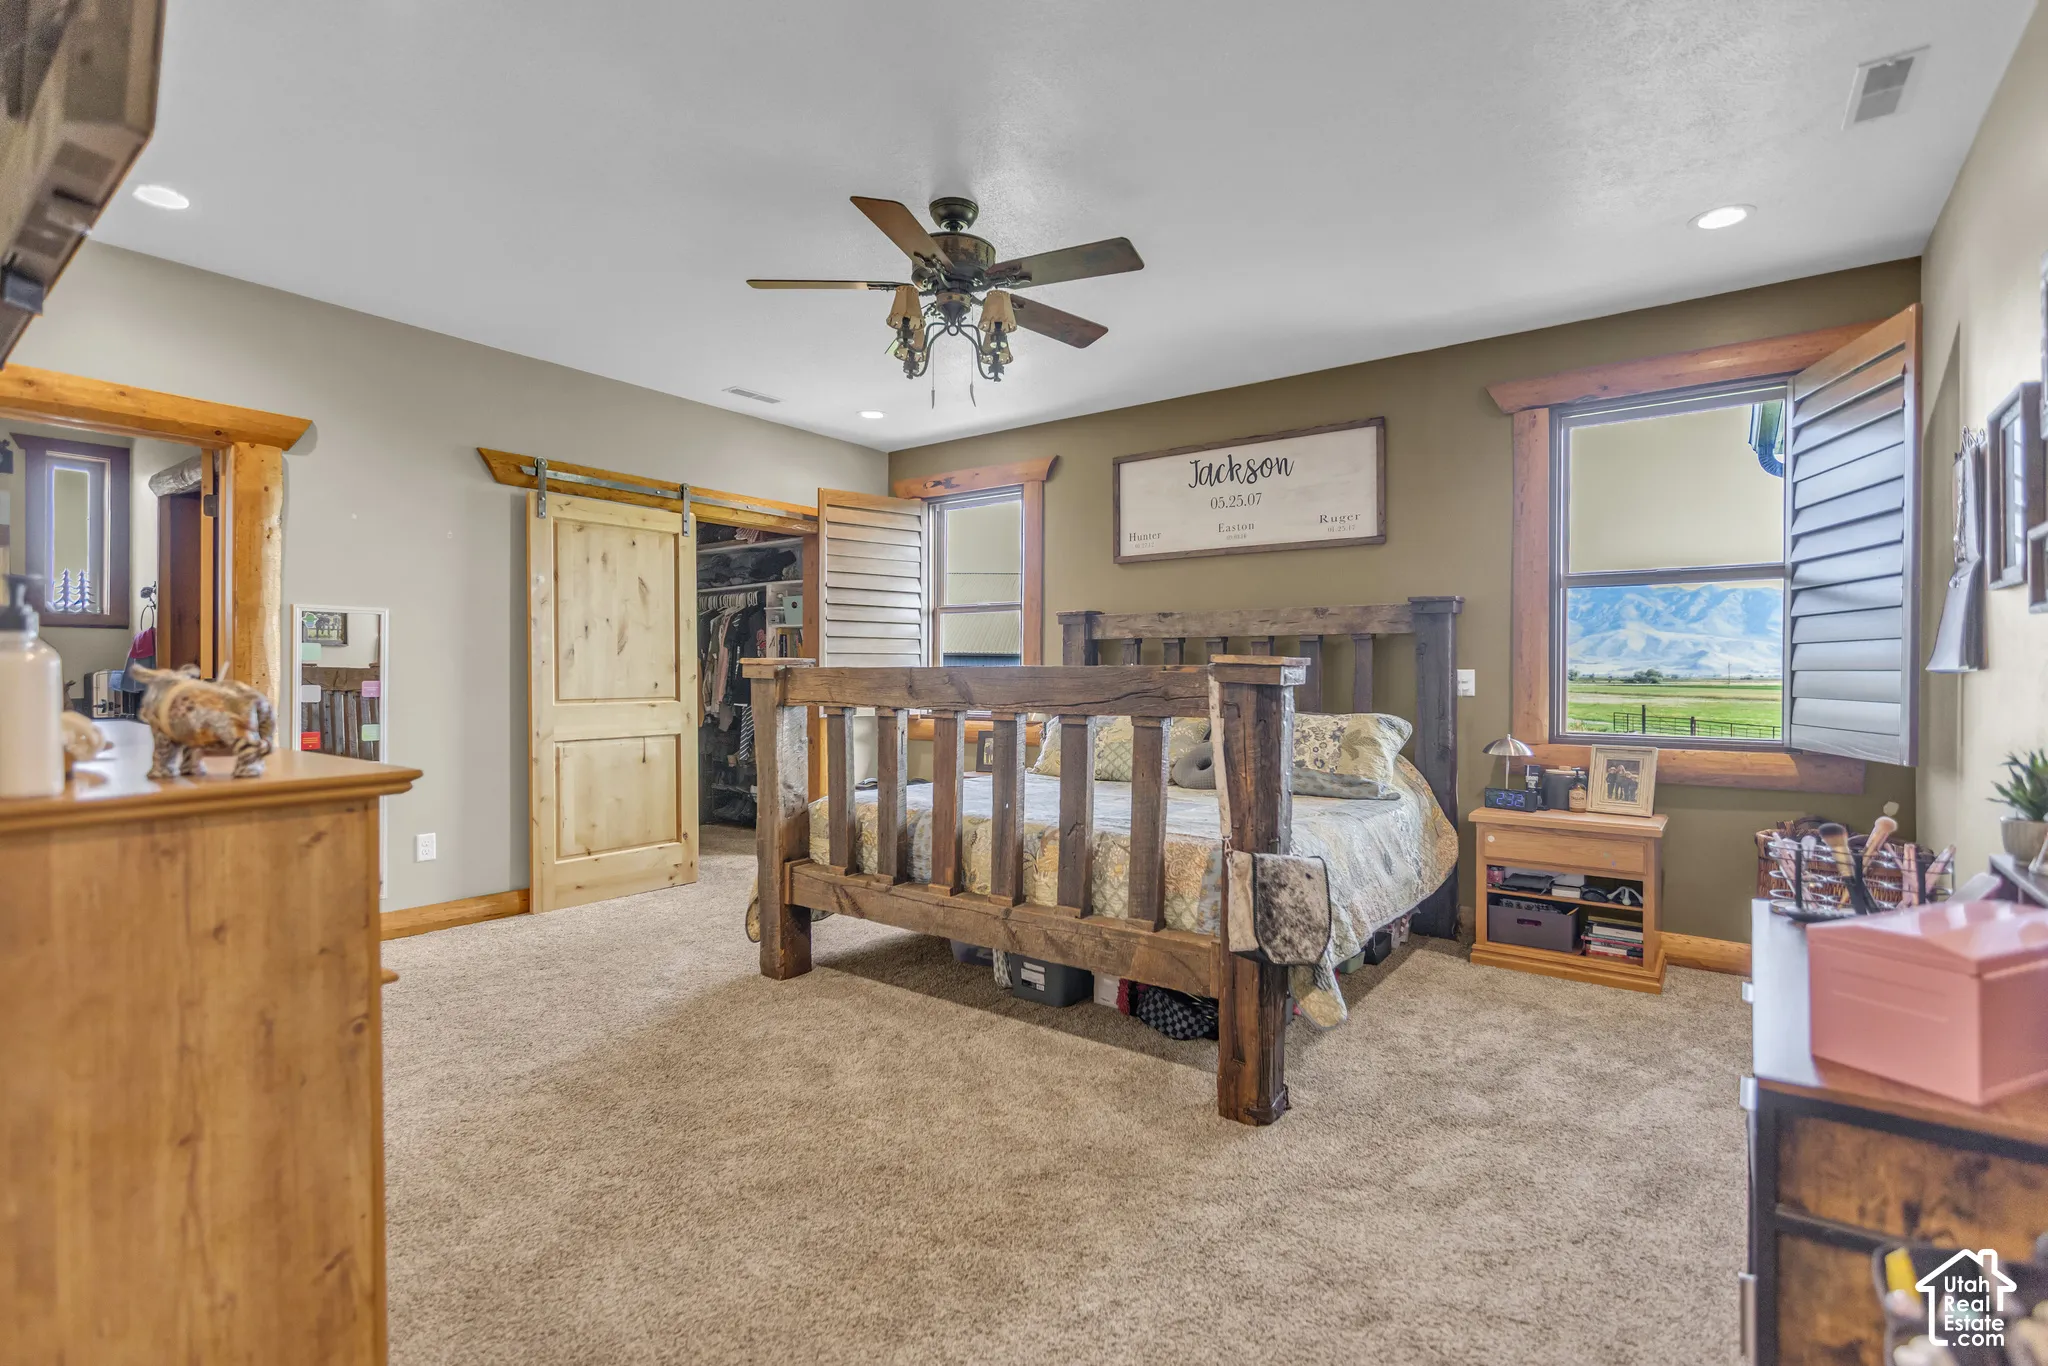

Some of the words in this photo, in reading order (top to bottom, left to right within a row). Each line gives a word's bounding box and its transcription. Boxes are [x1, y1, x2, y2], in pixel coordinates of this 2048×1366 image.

[1188, 454, 1294, 488] Jackson
[1210, 492, 1262, 509] 05.25.07
[1319, 513, 1361, 524] Ruger
[1218, 522, 1255, 533] Easton
[1129, 532, 1162, 541] Hunter
